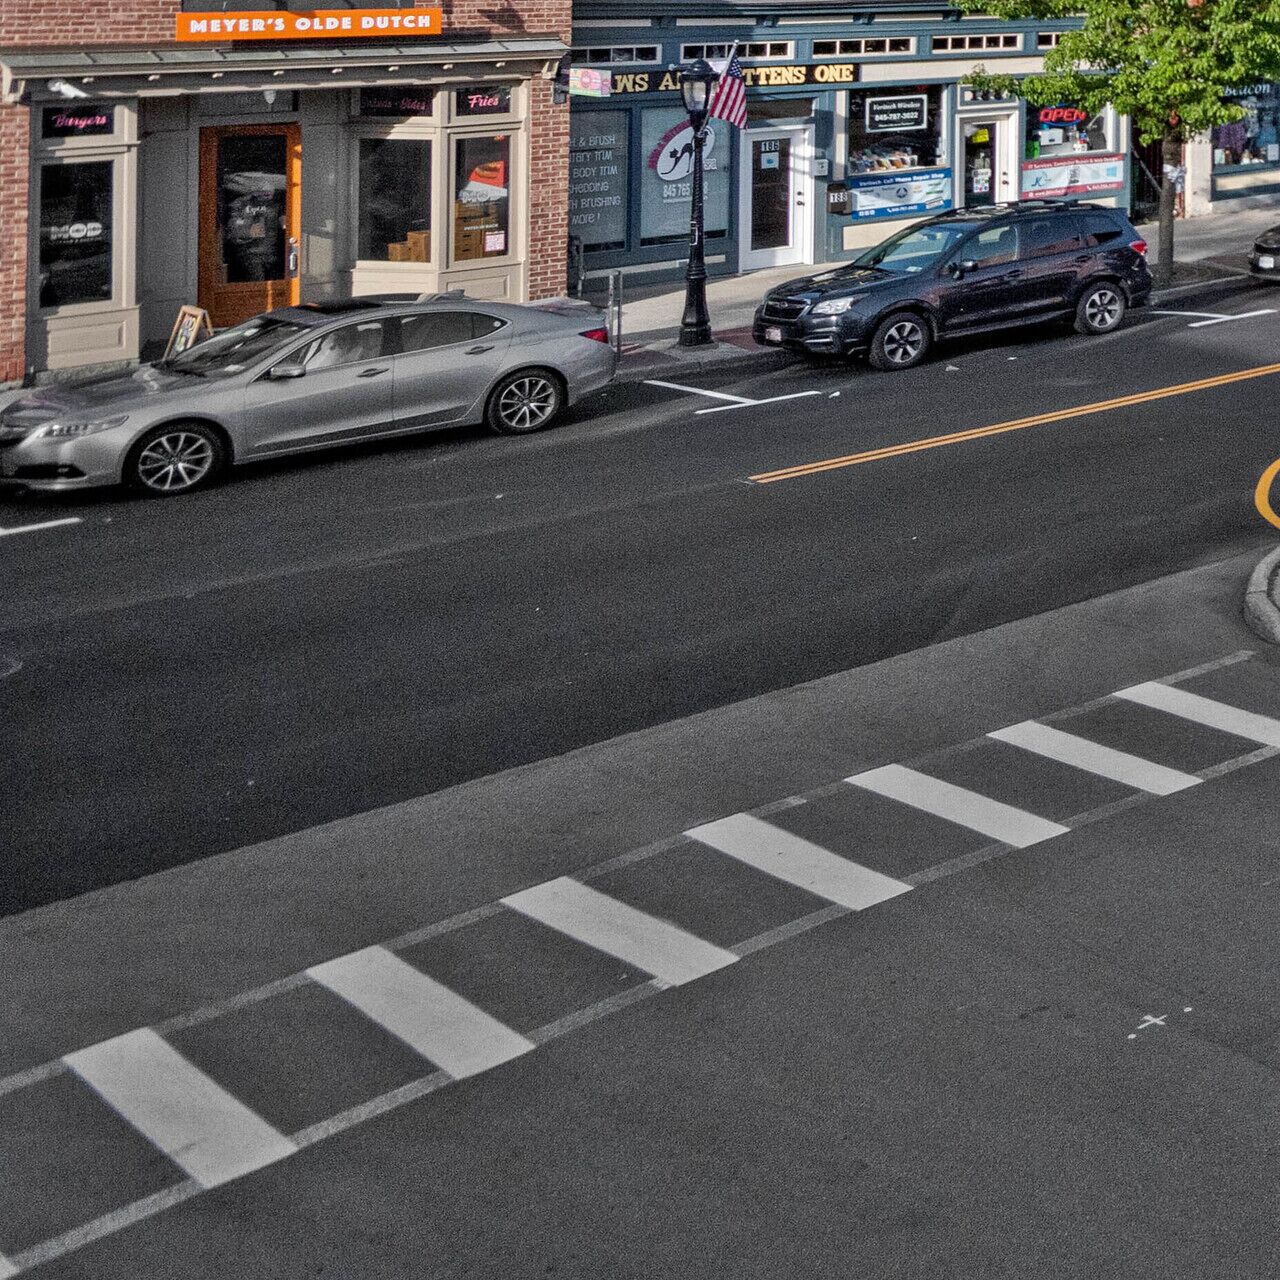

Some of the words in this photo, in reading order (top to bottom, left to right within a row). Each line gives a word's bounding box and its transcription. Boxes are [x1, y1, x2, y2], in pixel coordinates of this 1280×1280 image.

[189, 18, 286, 34] MEYER'S
[295, 16, 352, 31] OLDE
[361, 14, 431, 29] DUTCH
[610, 73, 650, 94] WS
[741, 66, 806, 86] TTENS
[814, 64, 855, 83] ONE
[467, 93, 500, 109] Fries
[52, 113, 108, 130] Burgers
[1039, 107, 1087, 123] OPEN
[761, 141, 779, 151] 186
[831, 191, 848, 203] 188
